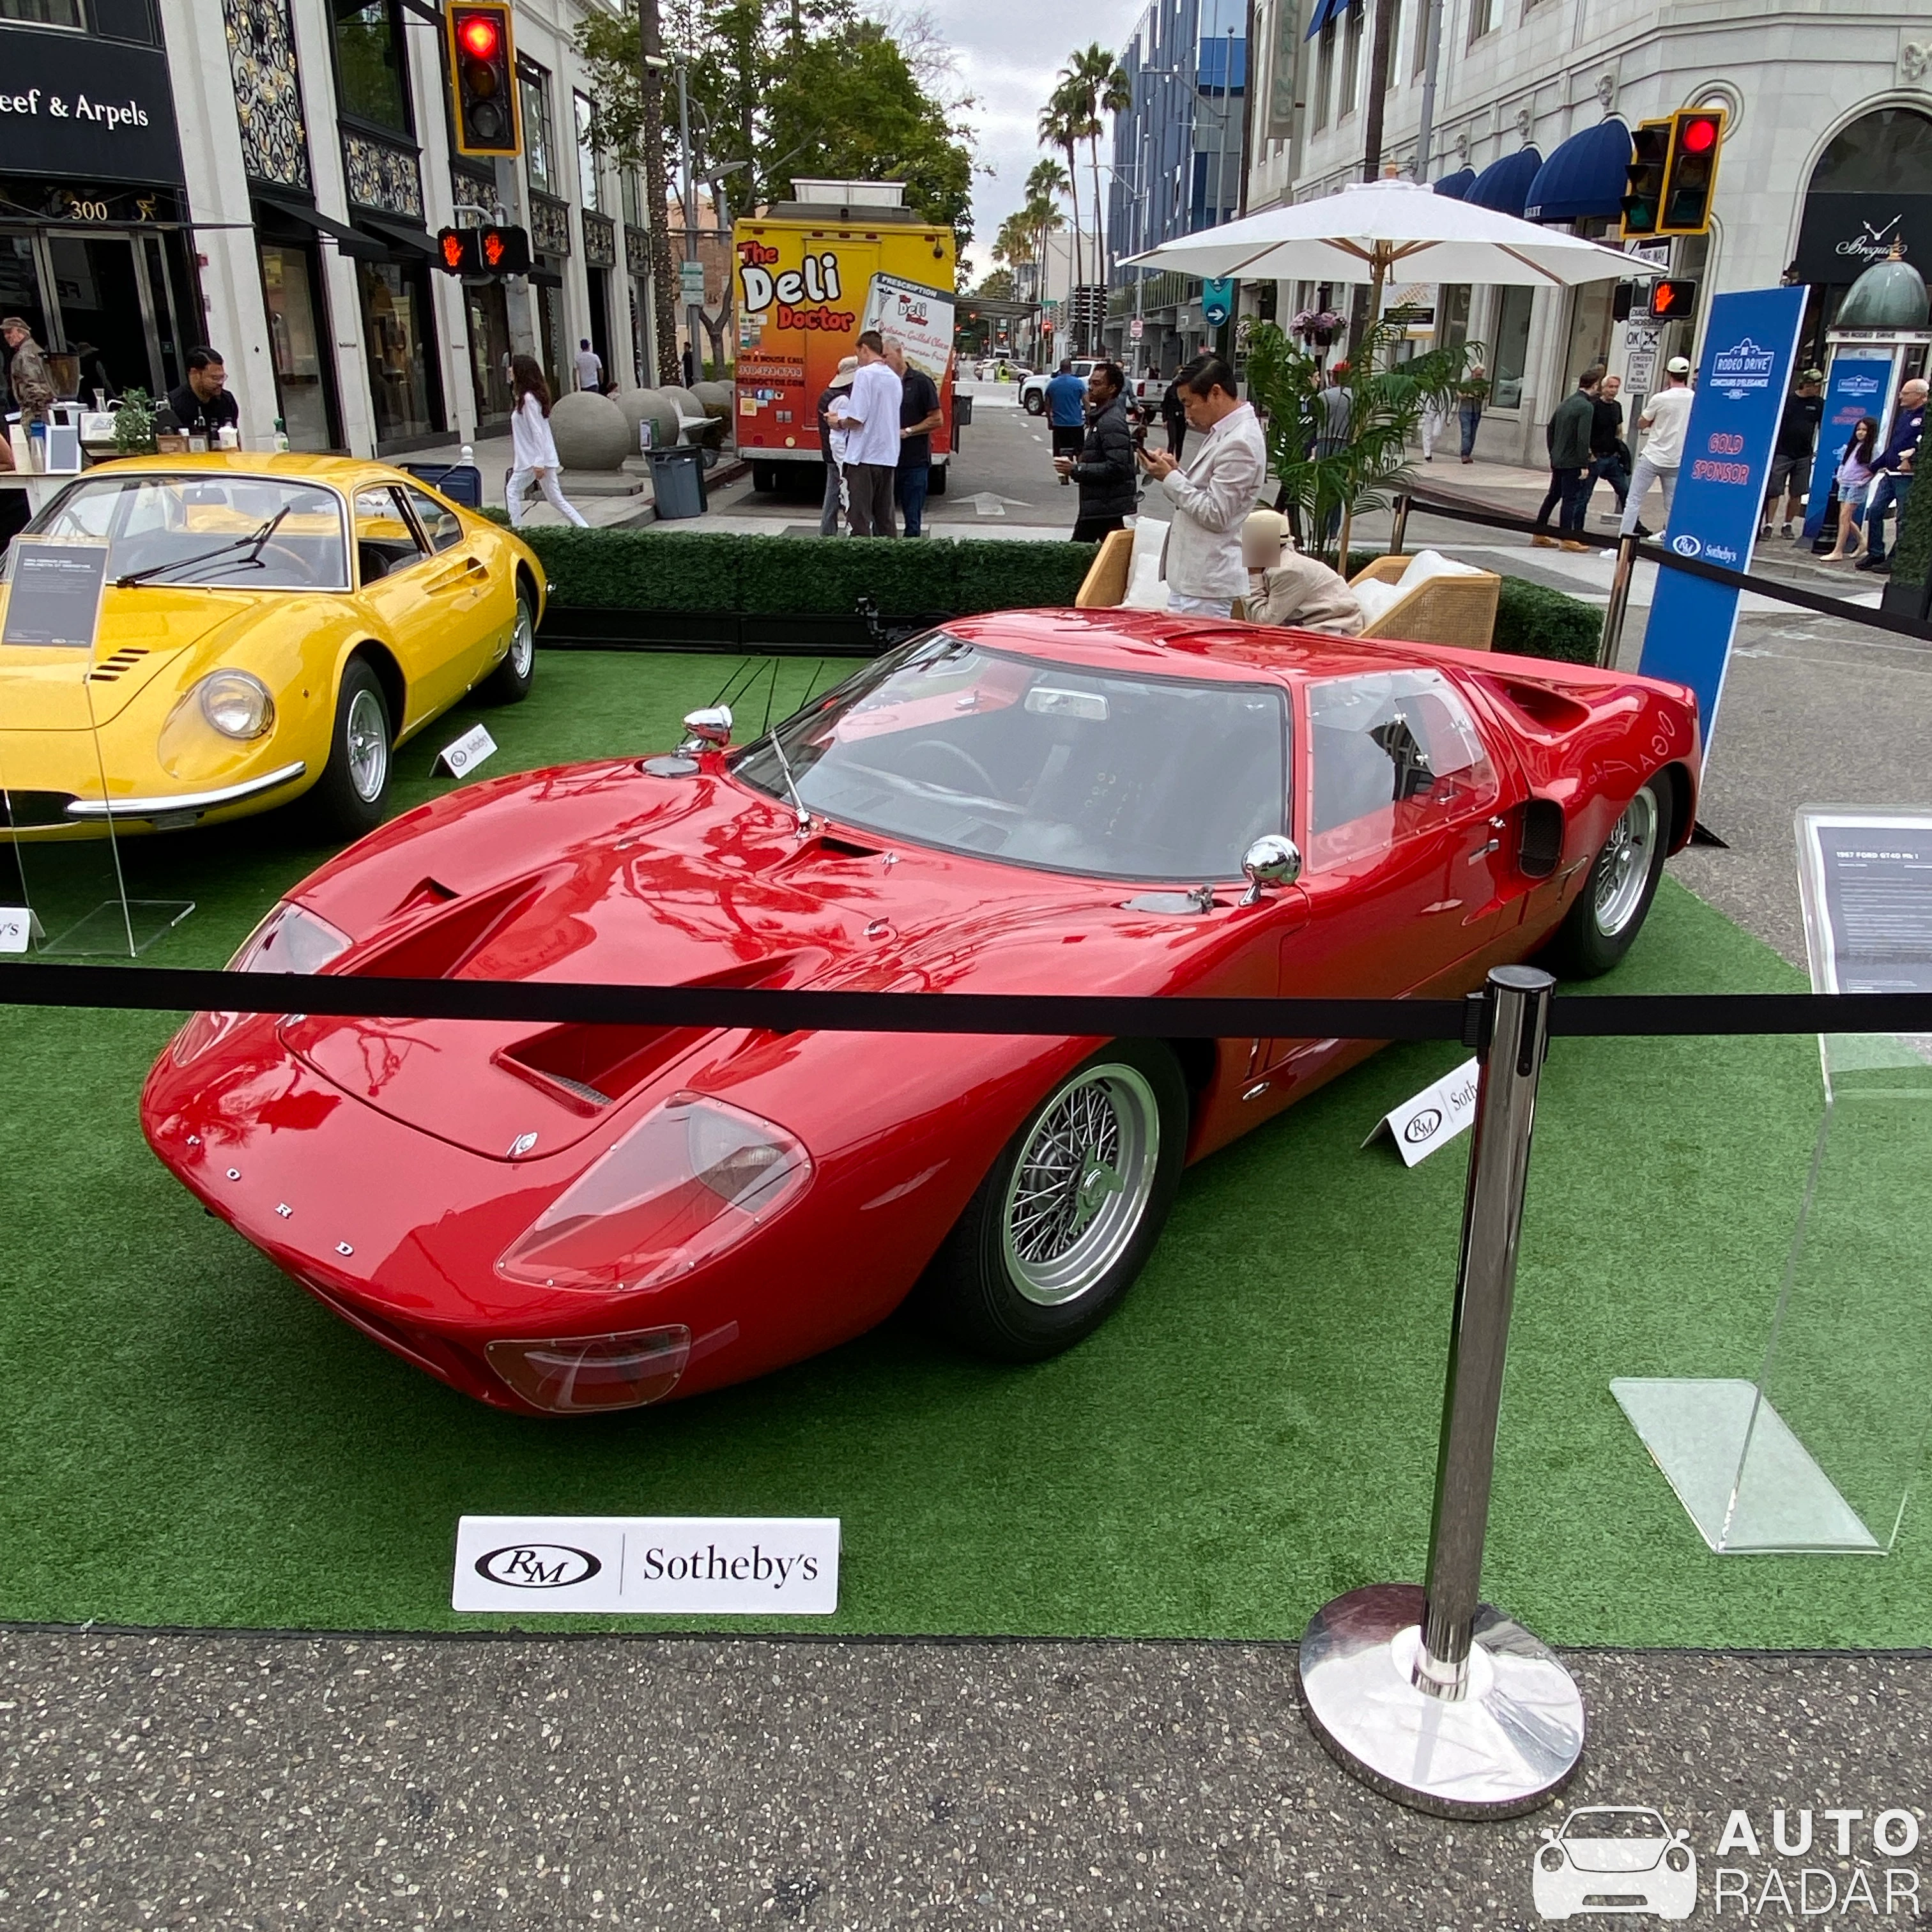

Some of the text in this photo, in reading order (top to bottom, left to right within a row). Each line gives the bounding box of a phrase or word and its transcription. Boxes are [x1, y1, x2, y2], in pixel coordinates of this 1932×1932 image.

[49, 96, 70, 118] &
[75, 94, 150, 130] Arpels
[70, 201, 108, 220] 300
[737, 240, 779, 264] The
[1836, 234, 1908, 263] Bregu
[739, 252, 841, 313] Deli
[777, 304, 855, 332] Doctor
[898, 302, 927, 318] Deli
[1627, 332, 1640, 344] OK
[1717, 357, 1768, 371] RODEO DRIVE
[1708, 433, 1744, 455] GOLD
[1692, 459, 1750, 486] SPONSOR
[1705, 544, 1737, 564] Sotheby's
[502, 1544, 818, 1590] RM Sotheby's
